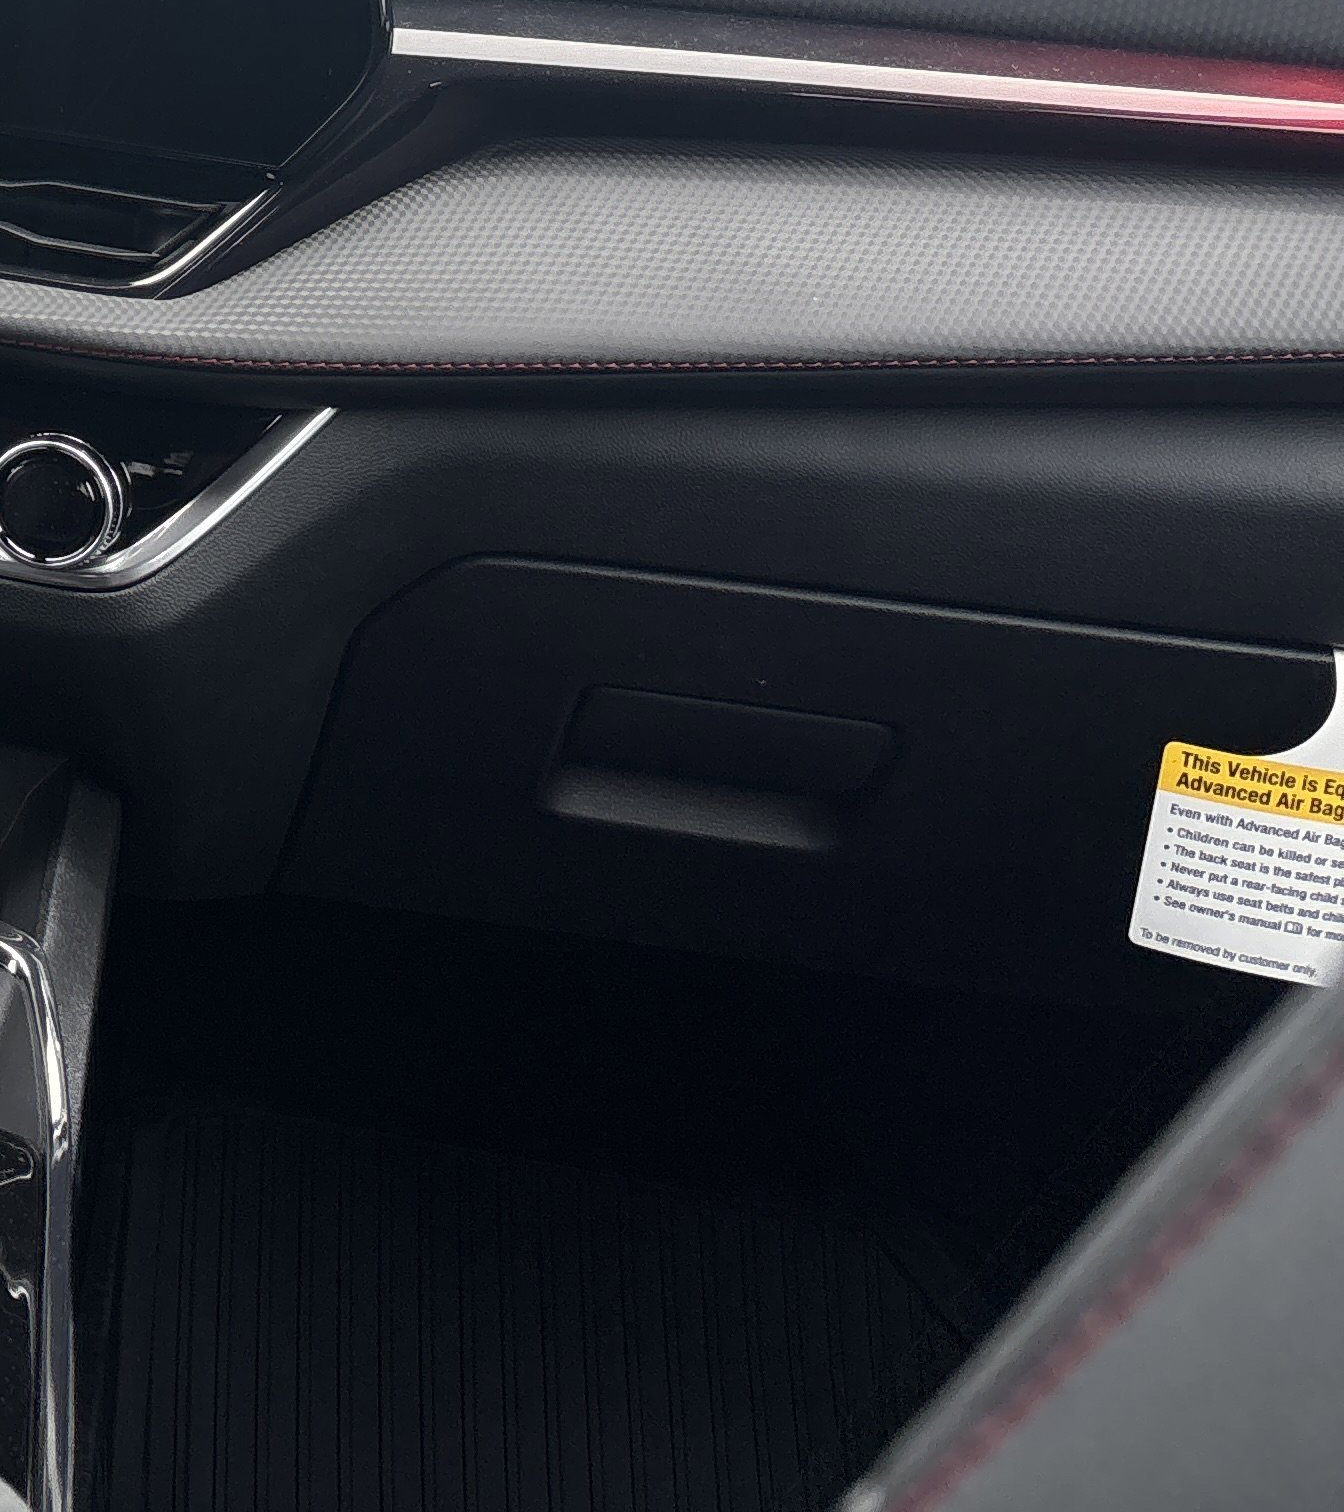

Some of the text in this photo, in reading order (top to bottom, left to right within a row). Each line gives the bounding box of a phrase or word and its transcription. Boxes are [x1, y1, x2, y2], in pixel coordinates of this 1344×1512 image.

[1181, 750, 1221, 775] This
[1227, 760, 1297, 789] Vehicle
[1301, 774, 1319, 793] is
[1176, 771, 1344, 822] Advanced Air Bag
[1169, 803, 1202, 821] Even
[1205, 812, 1234, 828] with
[1235, 817, 1301, 841] Advanced
[1301, 830, 1322, 844] Air
[1174, 843, 1196, 859] The
[1198, 849, 1229, 867] back
[1230, 859, 1257, 872] seat
[1259, 863, 1270, 875] is
[1273, 865, 1293, 879] the
[1294, 870, 1332, 886] safest
[1176, 827, 1230, 849] Children
[1232, 841, 1256, 855] can
[1258, 845, 1275, 858] be
[1277, 848, 1313, 865] killed
[1313, 856, 1329, 867] or
[1166, 879, 1210, 898] Always
[1212, 891, 1235, 903] use
[1236, 896, 1264, 910] seat
[1265, 900, 1295, 915] belts
[1297, 907, 1320, 920] and
[1170, 861, 1206, 879] Never
[1208, 872, 1229, 885] put
[1230, 876, 1239, 887] a
[1241, 879, 1308, 901] rear-facing
[1309, 891, 1339, 906] child
[1163, 895, 1187, 911] See
[1188, 903, 1236, 922] owner's
[1237, 914, 1282, 931] manual
[1306, 925, 1323, 938] for
[1139, 927, 1153, 940] To
[1155, 932, 1170, 945] be
[1171, 938, 1221, 957] removed
[1222, 948, 1237, 962] by
[1237, 953, 1291, 971] customer
